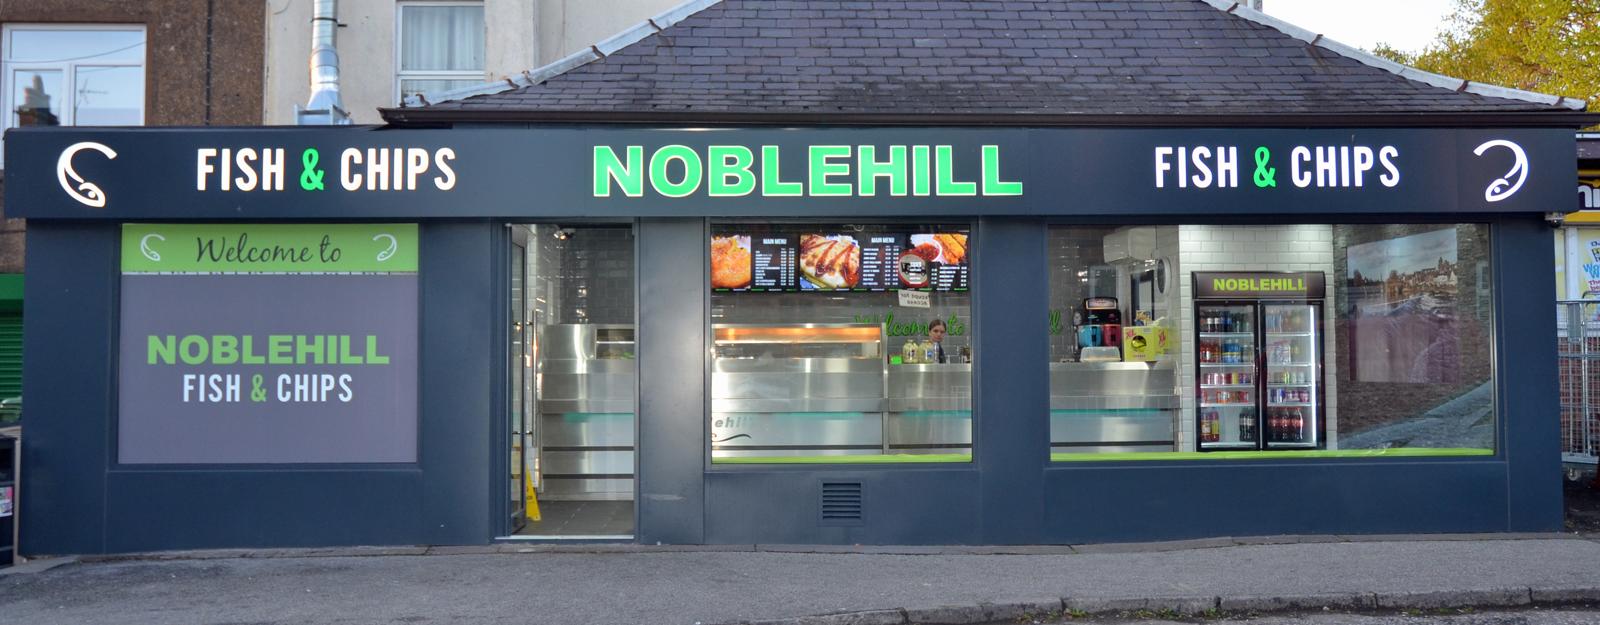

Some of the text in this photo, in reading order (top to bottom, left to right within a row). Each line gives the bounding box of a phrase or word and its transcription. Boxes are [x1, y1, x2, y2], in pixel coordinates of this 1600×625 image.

[196, 147, 457, 191] FISH & CHIPS
[593, 144, 1023, 197] NOBLEHILL
[1155, 145, 1400, 188] FISH & CHIPS
[196, 233, 341, 263] Welcome to
[1213, 278, 1307, 291] NOBLEHILL
[147, 335, 390, 364] NOBLEHILL
[182, 374, 353, 402] FISH & CHIPS
